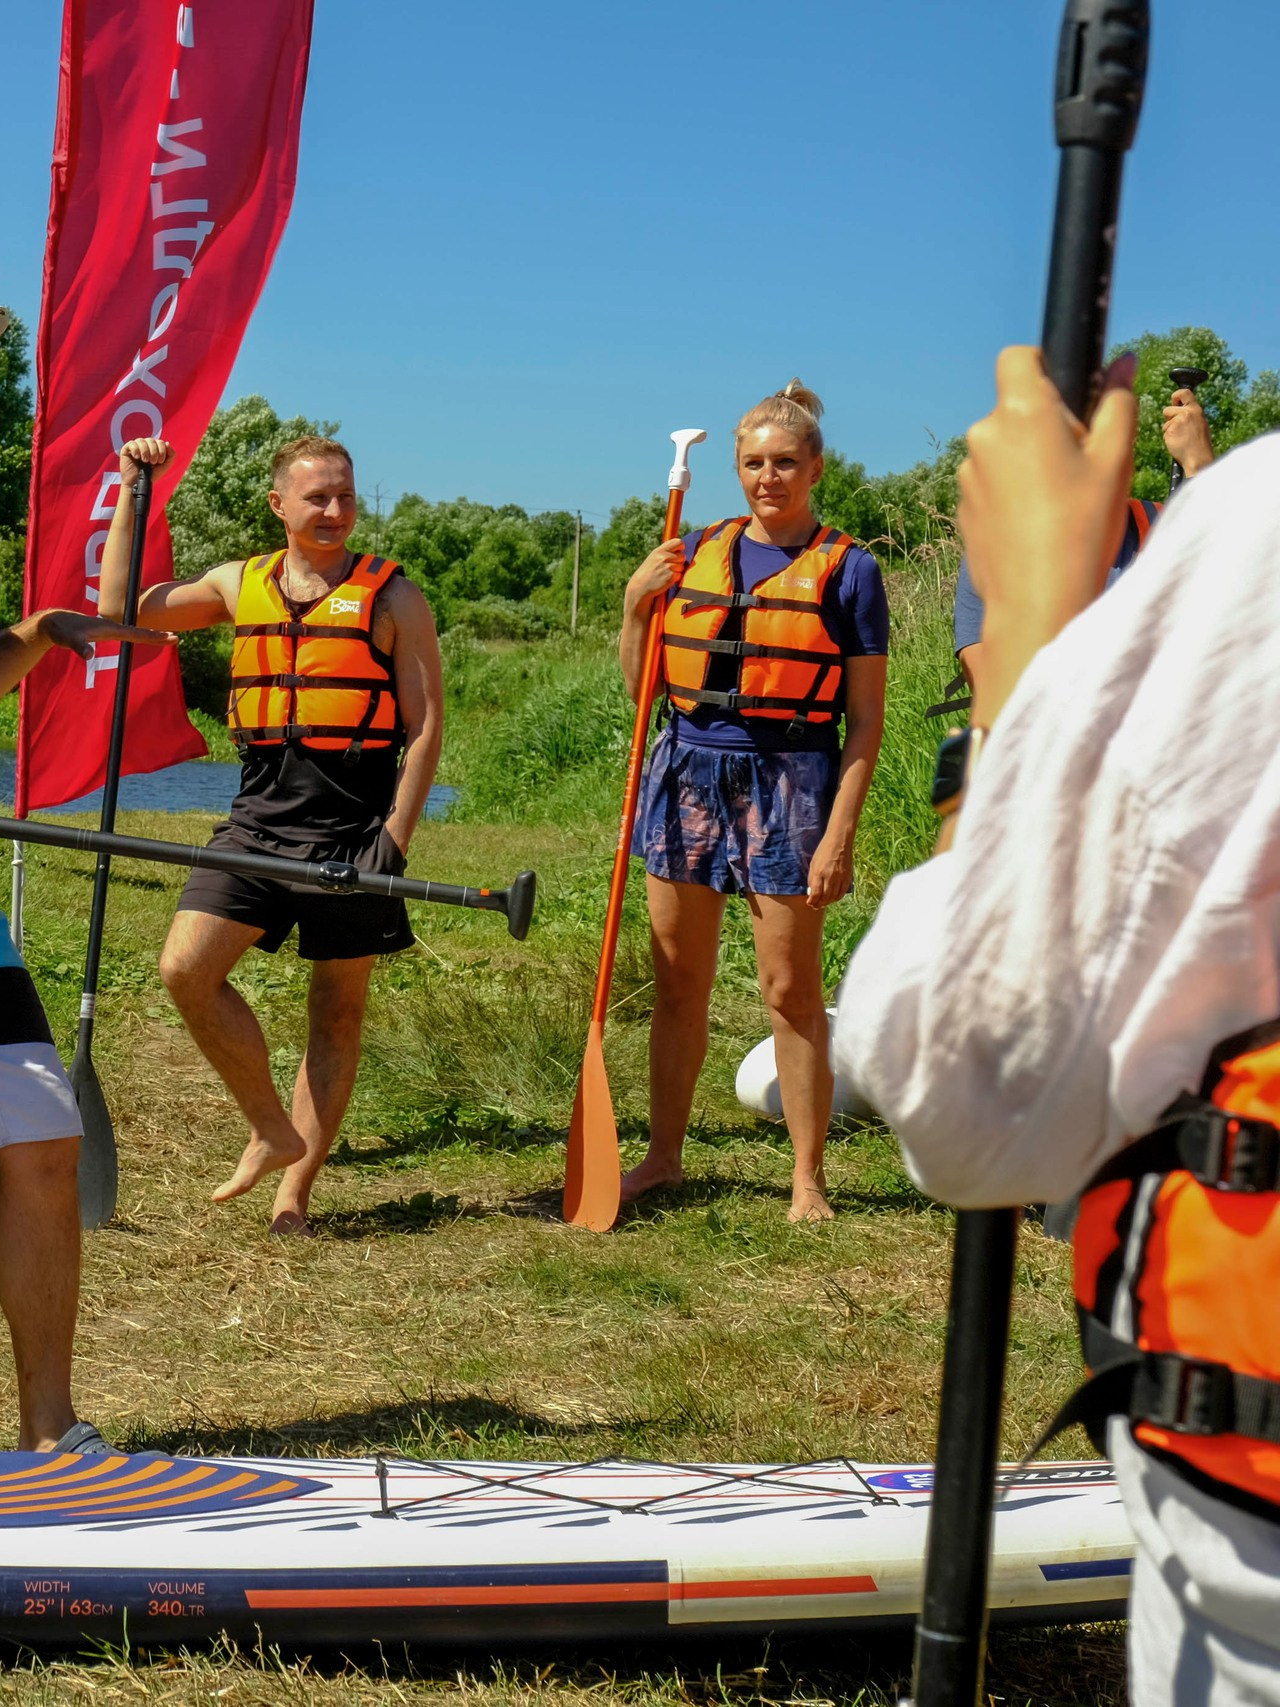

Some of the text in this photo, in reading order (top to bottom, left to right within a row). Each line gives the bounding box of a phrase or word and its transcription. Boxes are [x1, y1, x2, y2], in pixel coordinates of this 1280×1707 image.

[996, 1470, 1119, 1482] GLAD
[24, 1580, 70, 1593] WIDTH
[148, 1582, 205, 1595] VOLUME
